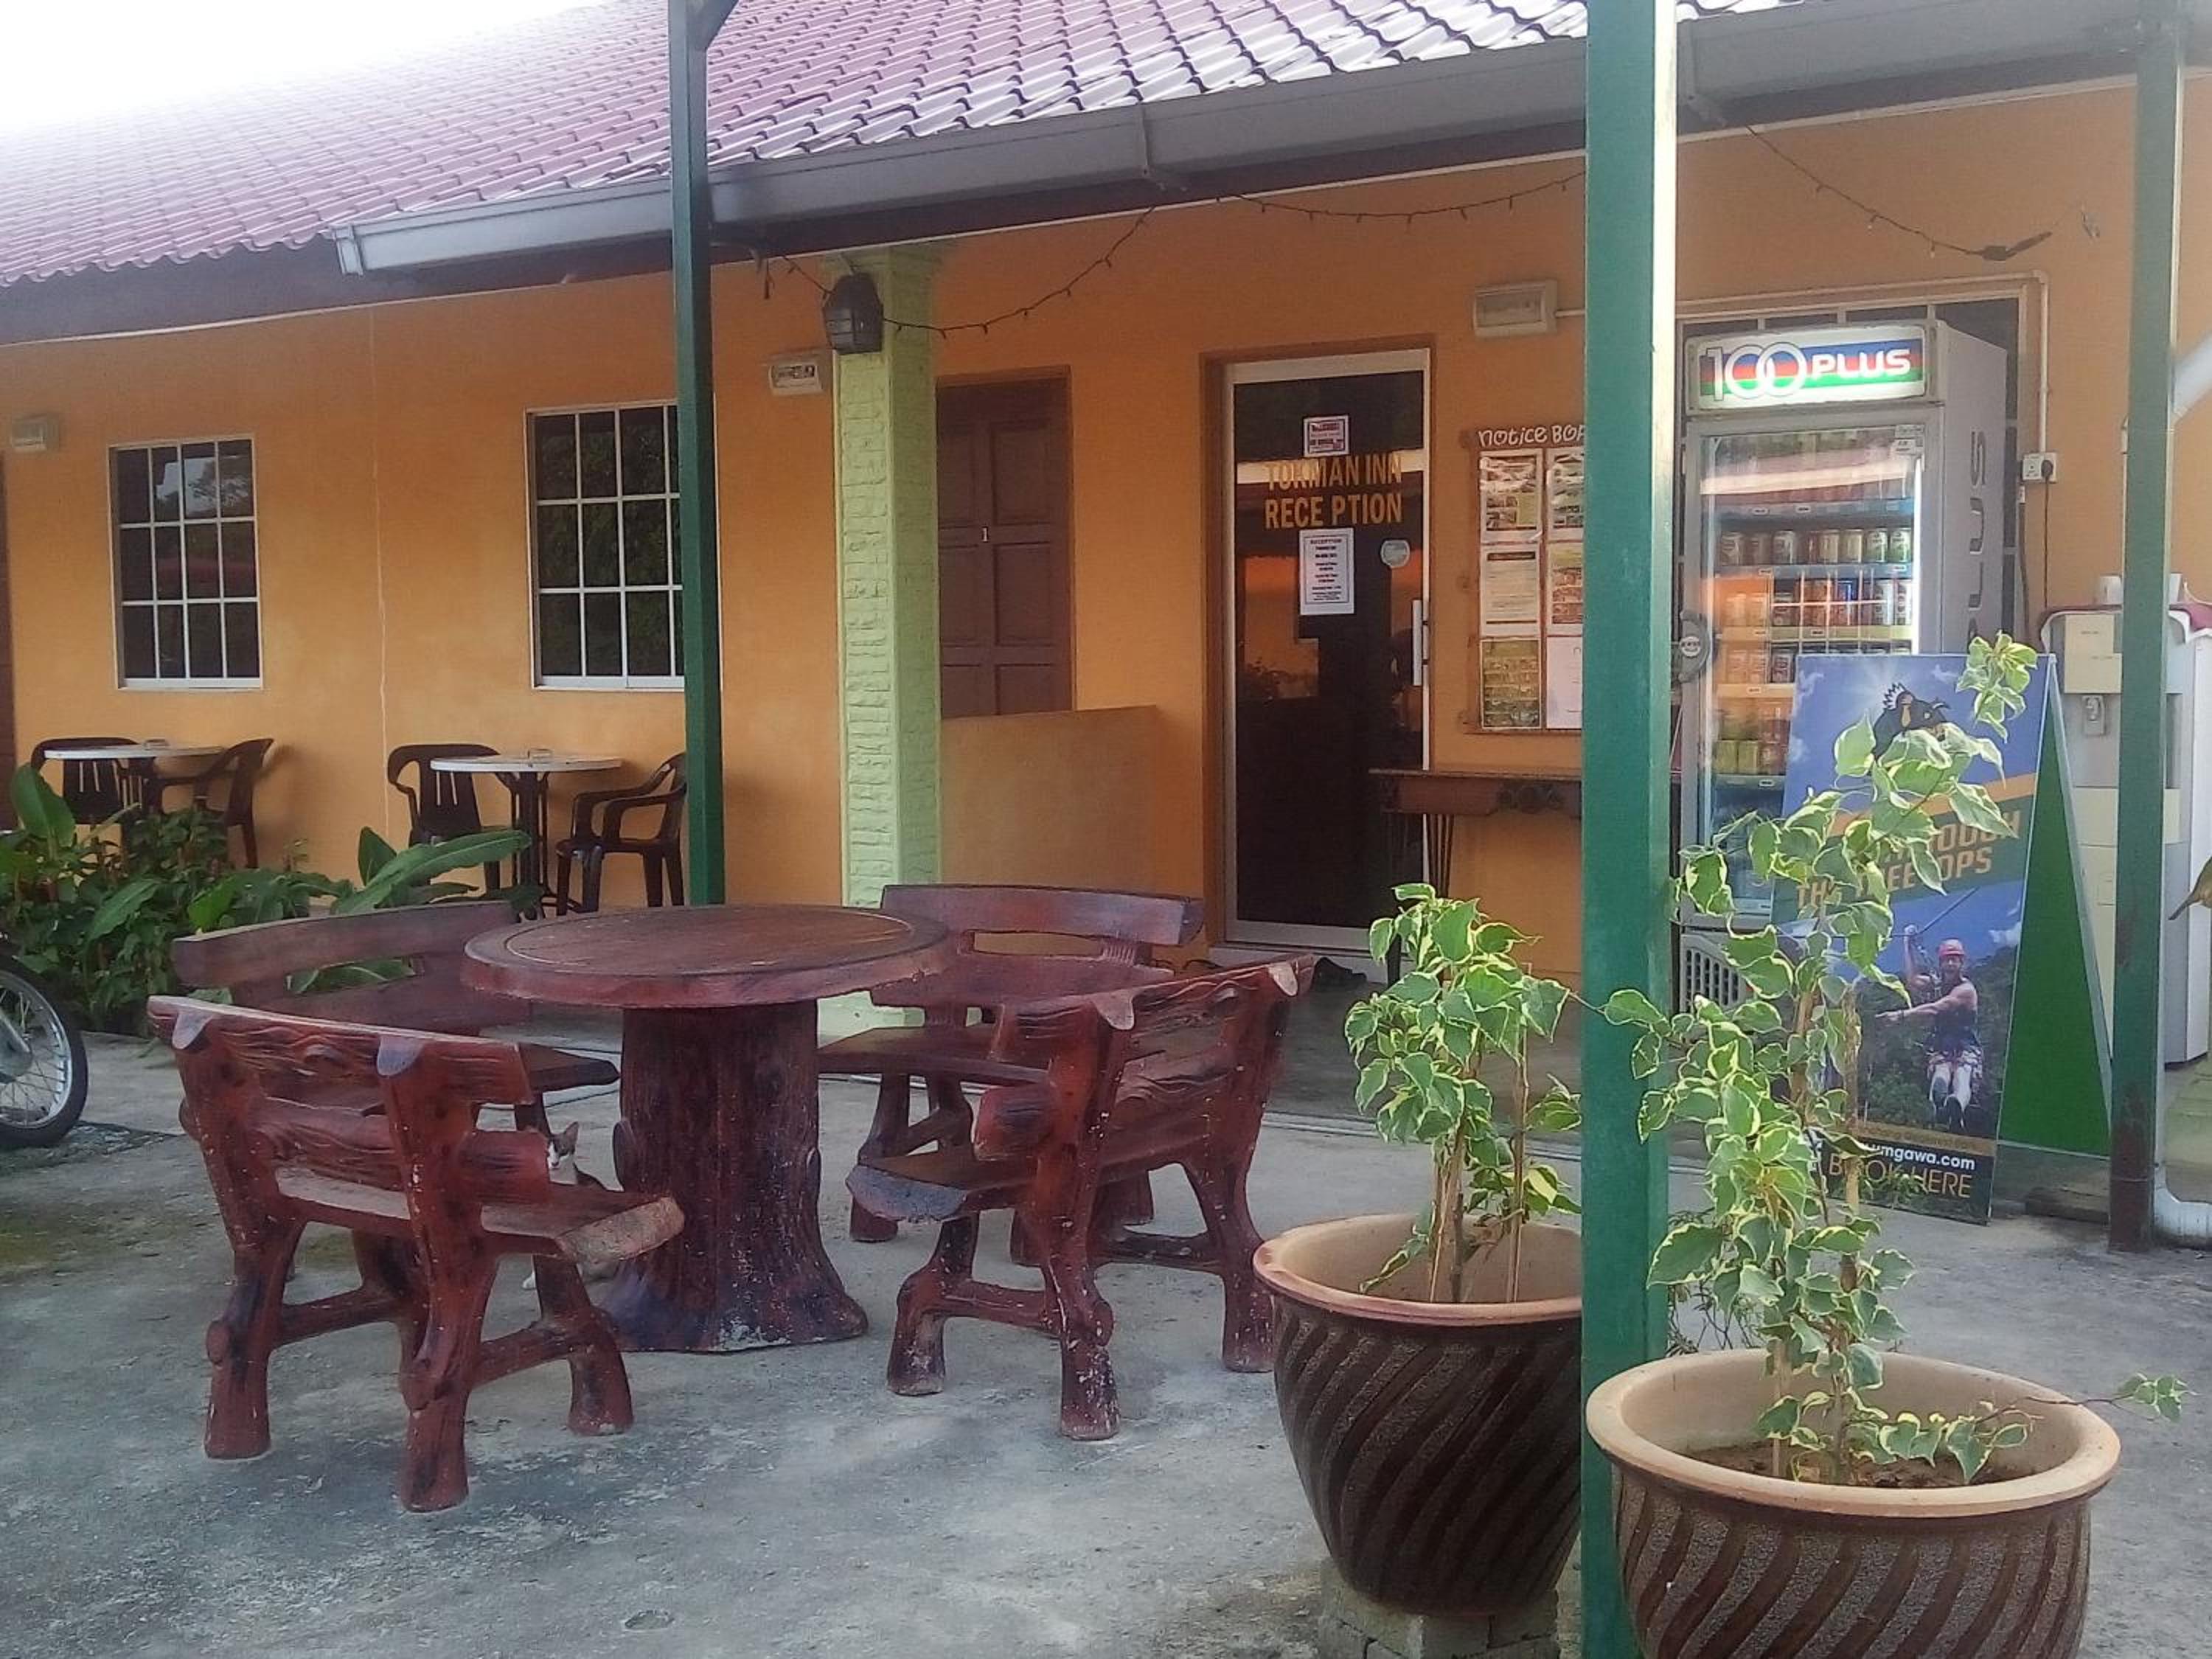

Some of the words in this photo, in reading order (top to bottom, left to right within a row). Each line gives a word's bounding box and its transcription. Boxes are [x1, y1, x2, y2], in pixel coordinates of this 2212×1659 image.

[1705, 341, 1807, 402] 100
[1811, 349, 1911, 381] PLUS
[1365, 451, 1402, 484] INN
[1828, 1152, 1907, 1186] BOK
